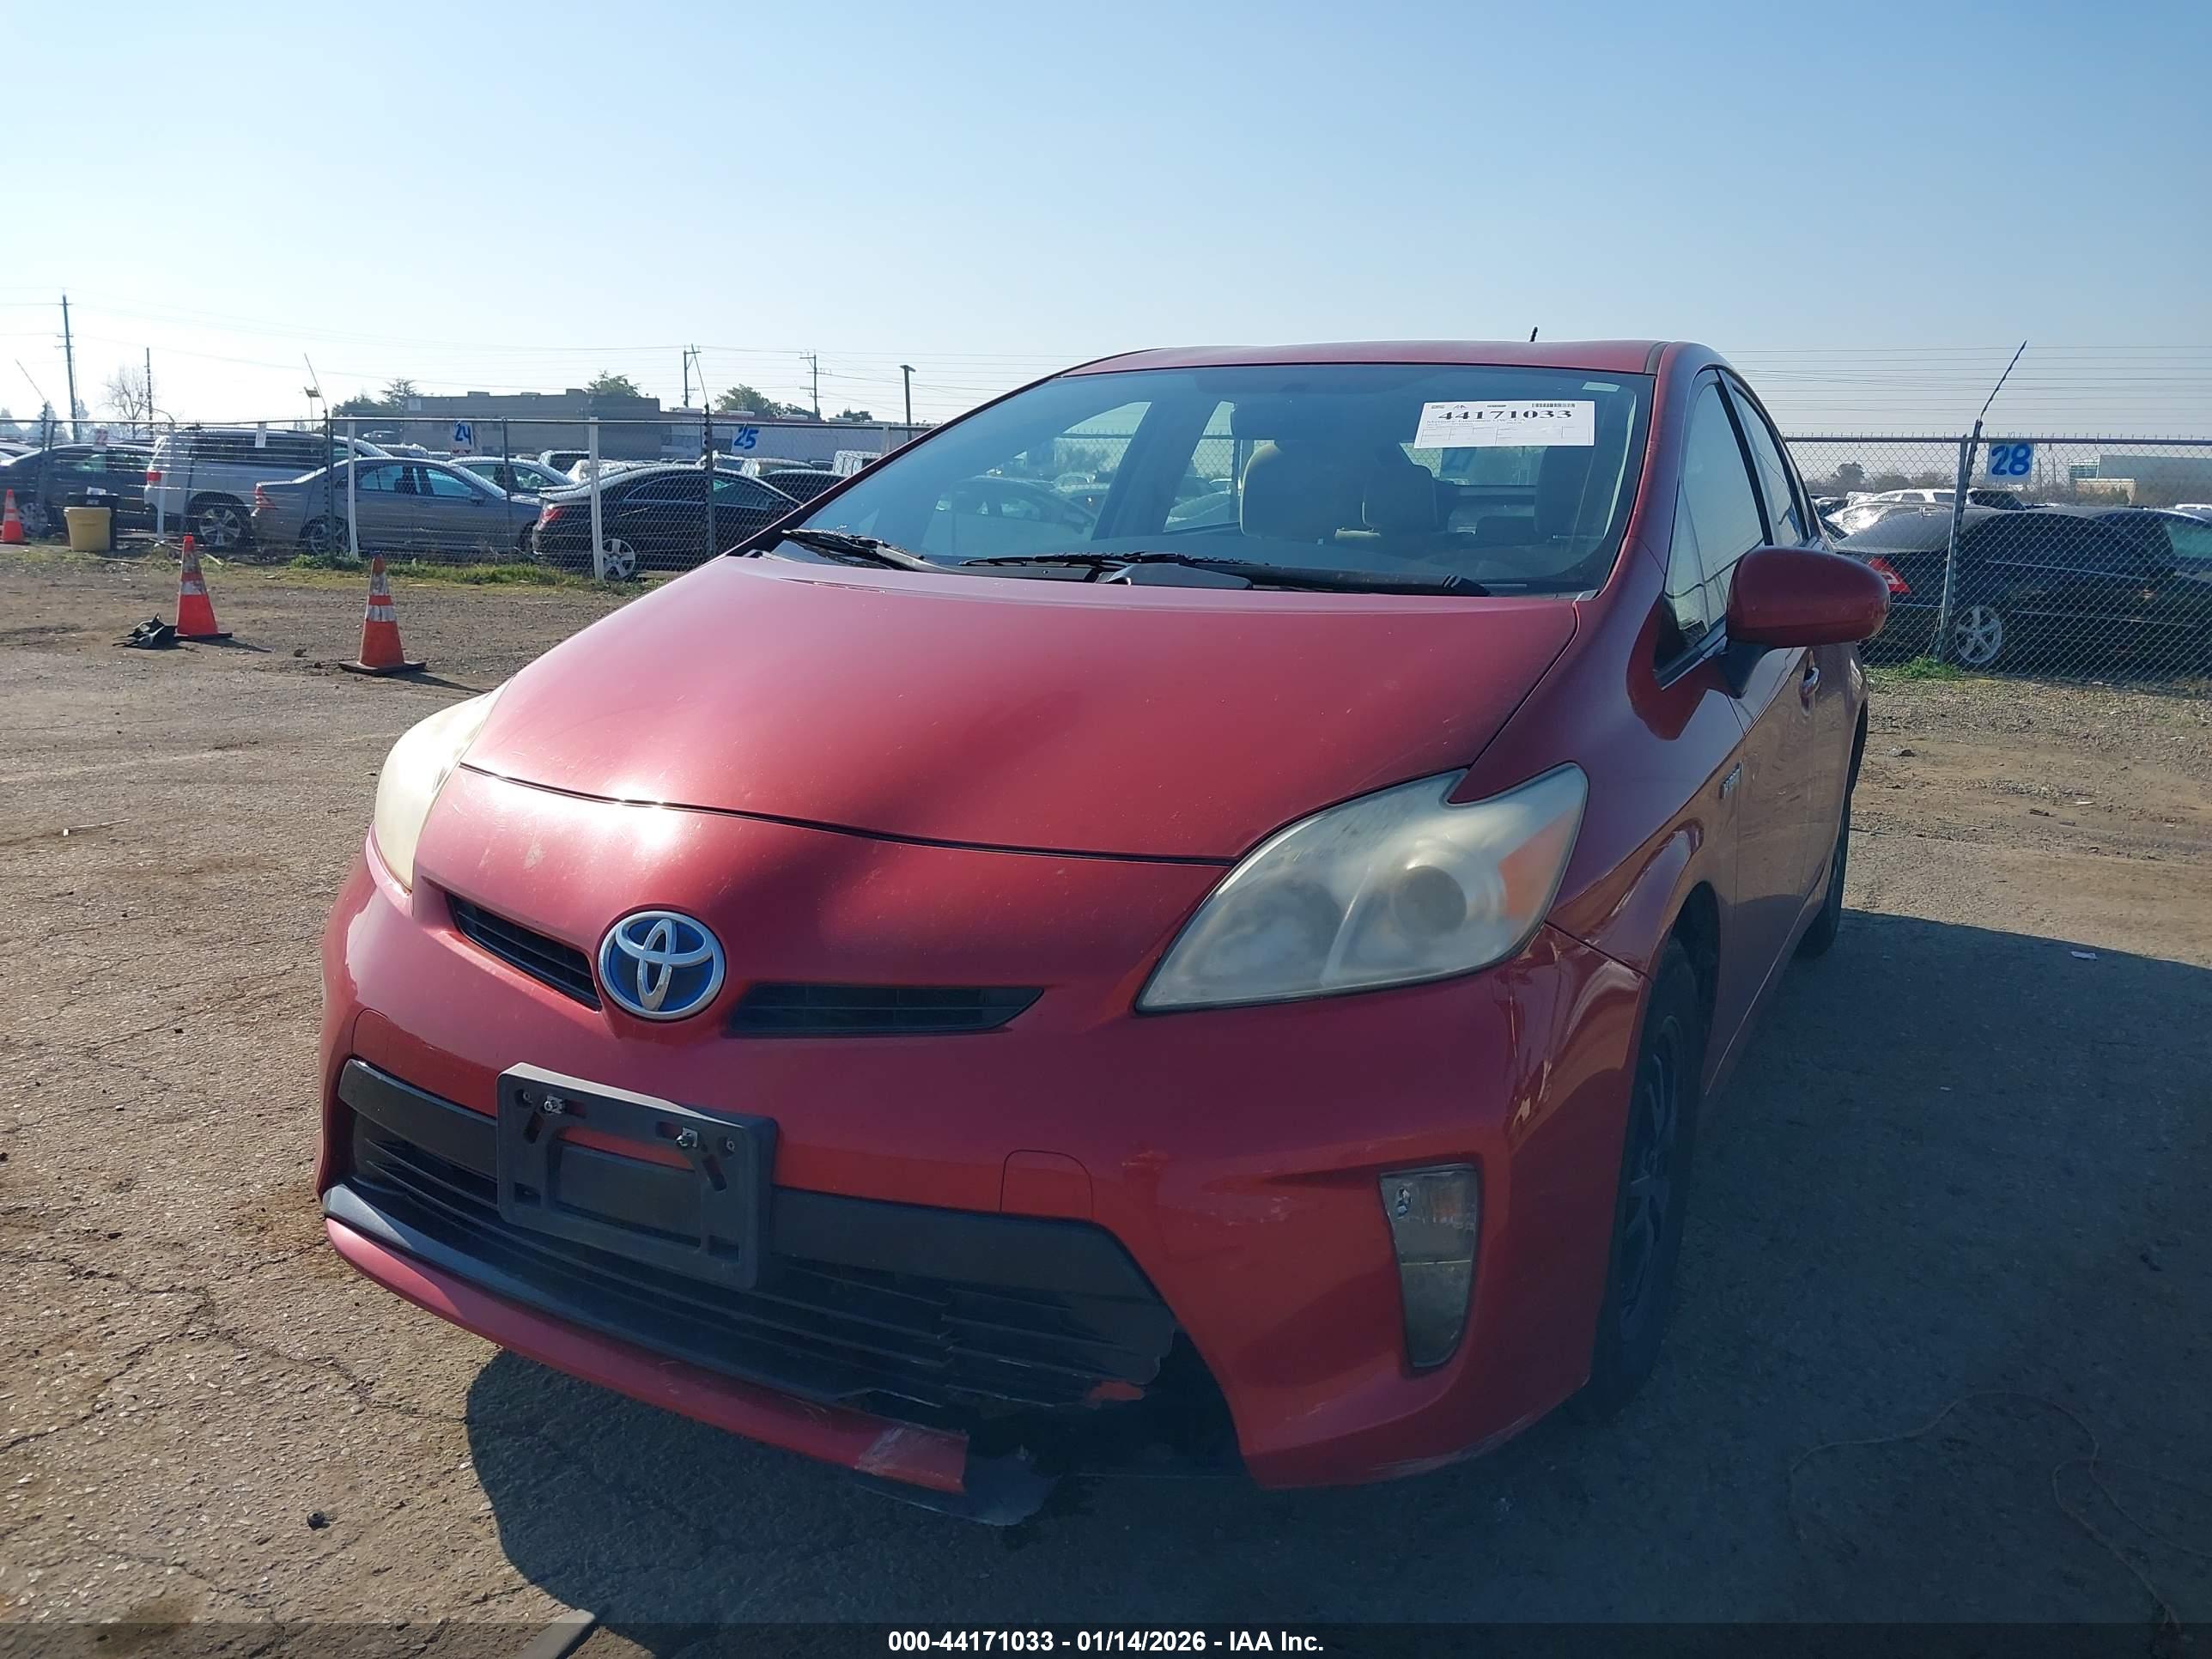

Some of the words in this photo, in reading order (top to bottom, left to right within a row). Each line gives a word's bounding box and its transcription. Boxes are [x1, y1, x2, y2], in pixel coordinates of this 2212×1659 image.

[1437, 410, 1572, 420] 44171033
[454, 422, 472, 446] 24
[733, 425, 759, 450] 25
[1991, 442, 2031, 476] 28
